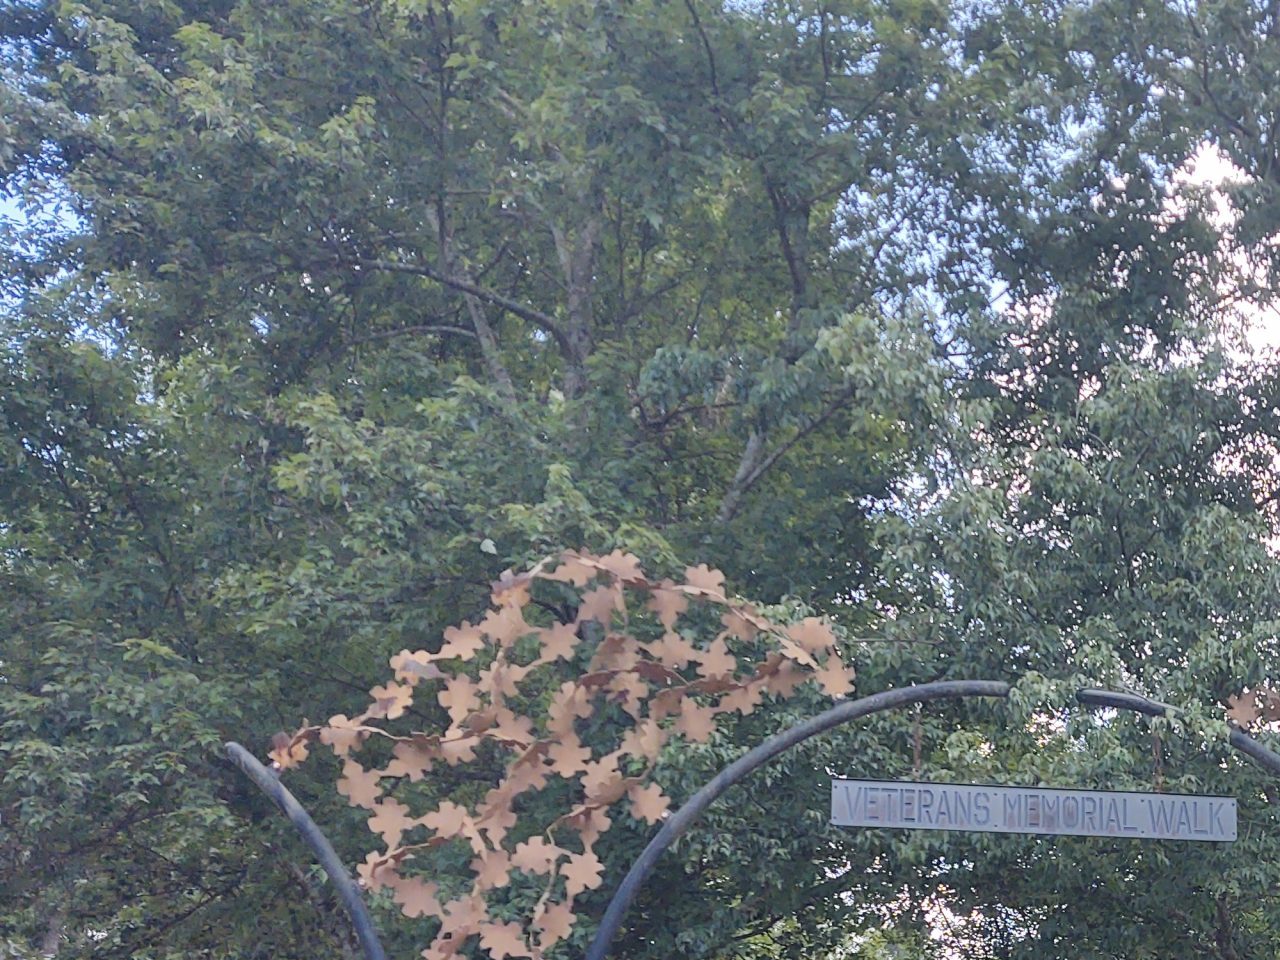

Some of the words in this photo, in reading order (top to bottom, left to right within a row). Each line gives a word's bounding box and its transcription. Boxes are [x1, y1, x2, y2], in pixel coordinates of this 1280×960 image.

[843, 785, 990, 826] VETERANS
[1001, 794, 1139, 832] MEMORIAL
[1147, 799, 1225, 836] WALK
